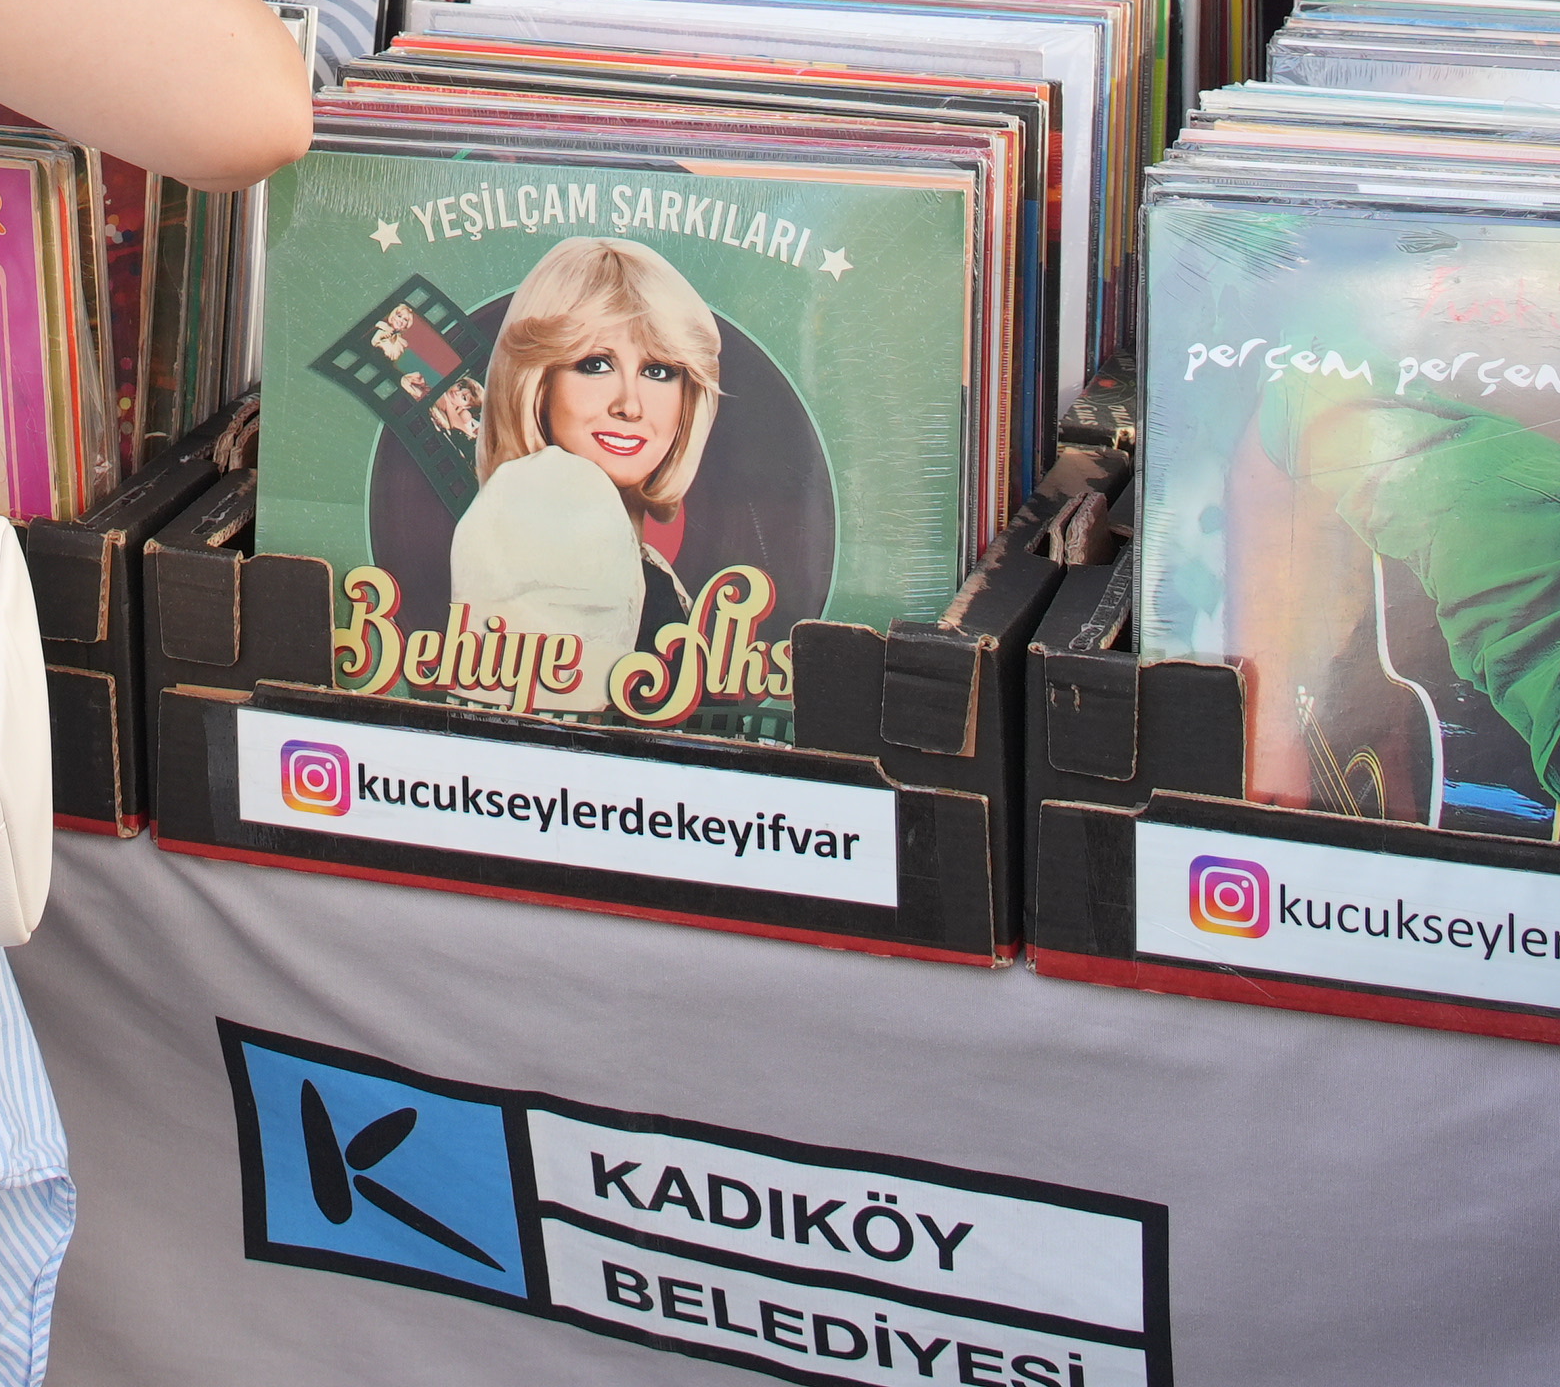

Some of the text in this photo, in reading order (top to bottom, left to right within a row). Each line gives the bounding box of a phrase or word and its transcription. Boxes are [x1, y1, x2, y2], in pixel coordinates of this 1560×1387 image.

[411, 181, 811, 267] YEŞİLÇAM ŞARKILARI
[1183, 337, 1374, 384] perçem
[334, 564, 793, 727] Behiye Aks
[356, 762, 860, 861] kucukseylerdekeyifvar
[589, 1151, 975, 1272] KADIKÖY
[601, 1260, 1086, 1387] BELEDİYESİ
